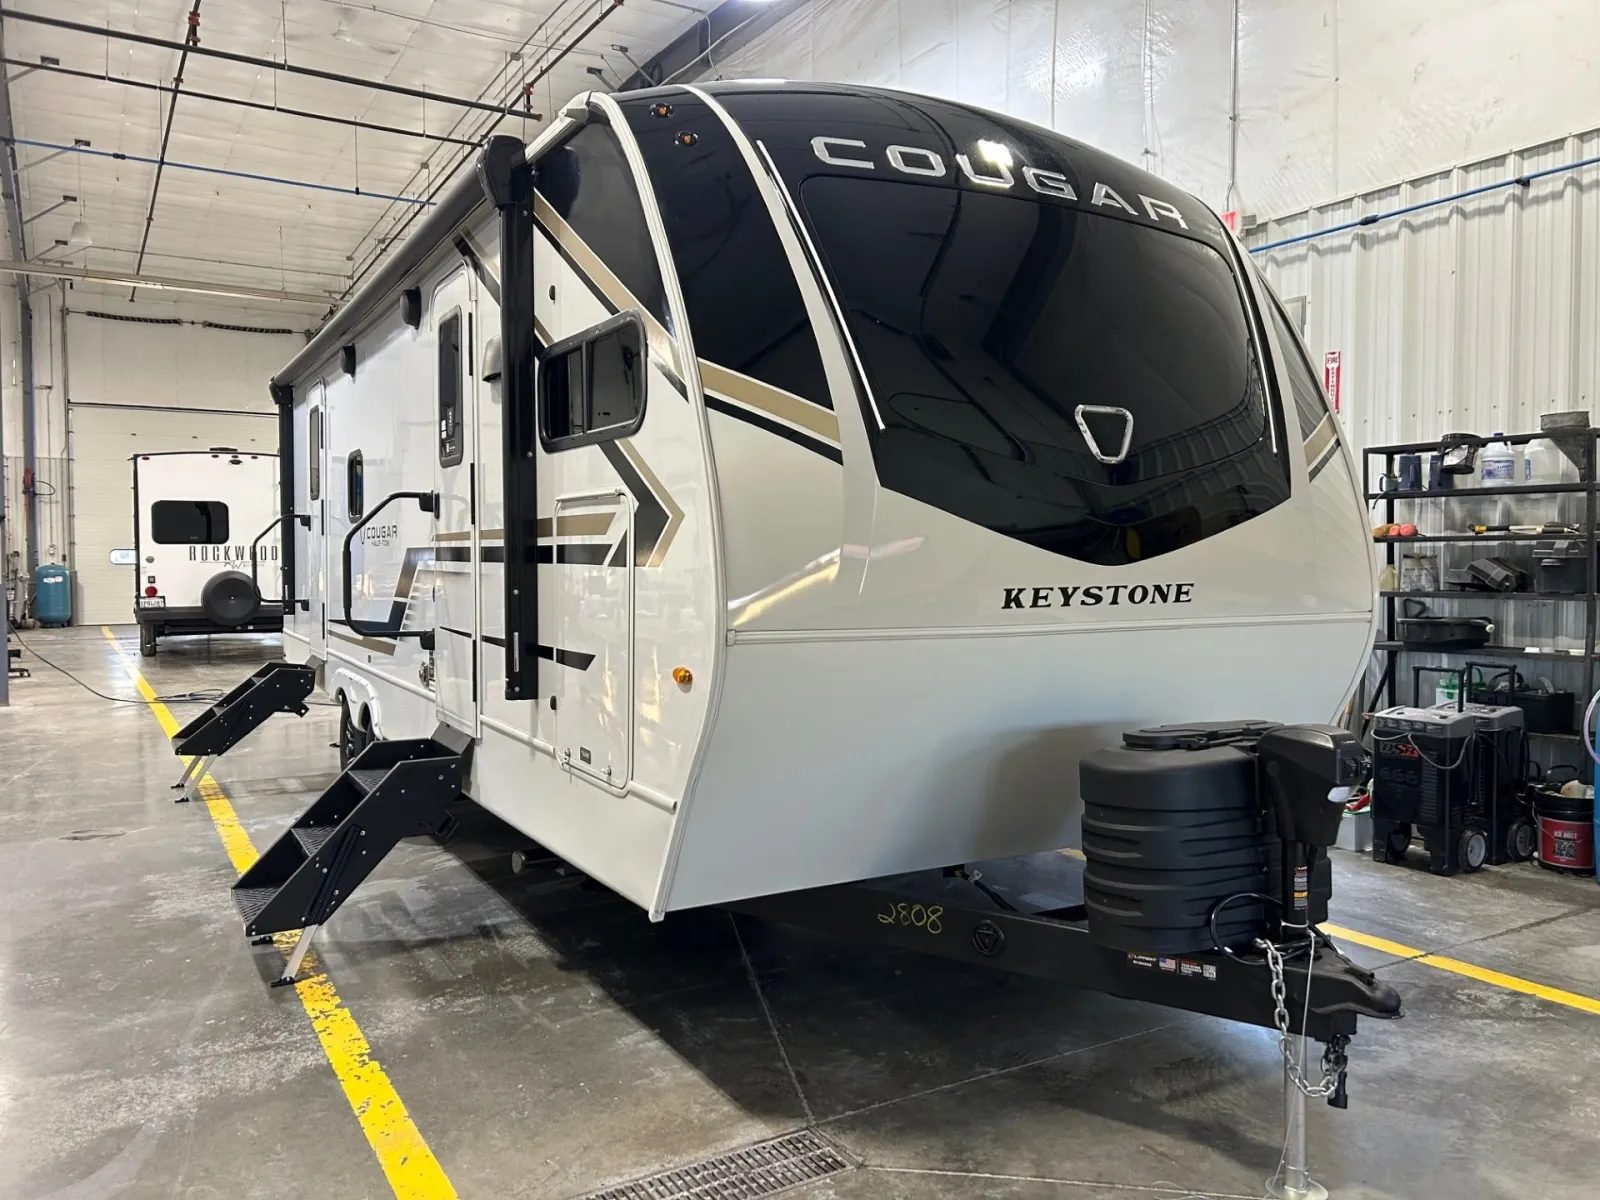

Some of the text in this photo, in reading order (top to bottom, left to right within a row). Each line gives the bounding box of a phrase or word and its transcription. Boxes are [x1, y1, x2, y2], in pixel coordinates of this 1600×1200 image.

[810, 136, 1188, 231] COUGAR
[1327, 356, 1339, 364] FIRE
[367, 525, 398, 539] COUGAR
[189, 545, 279, 561] ROCKWOOD
[1001, 583, 1195, 609] KEYSTONE
[878, 903, 944, 934] 2808
